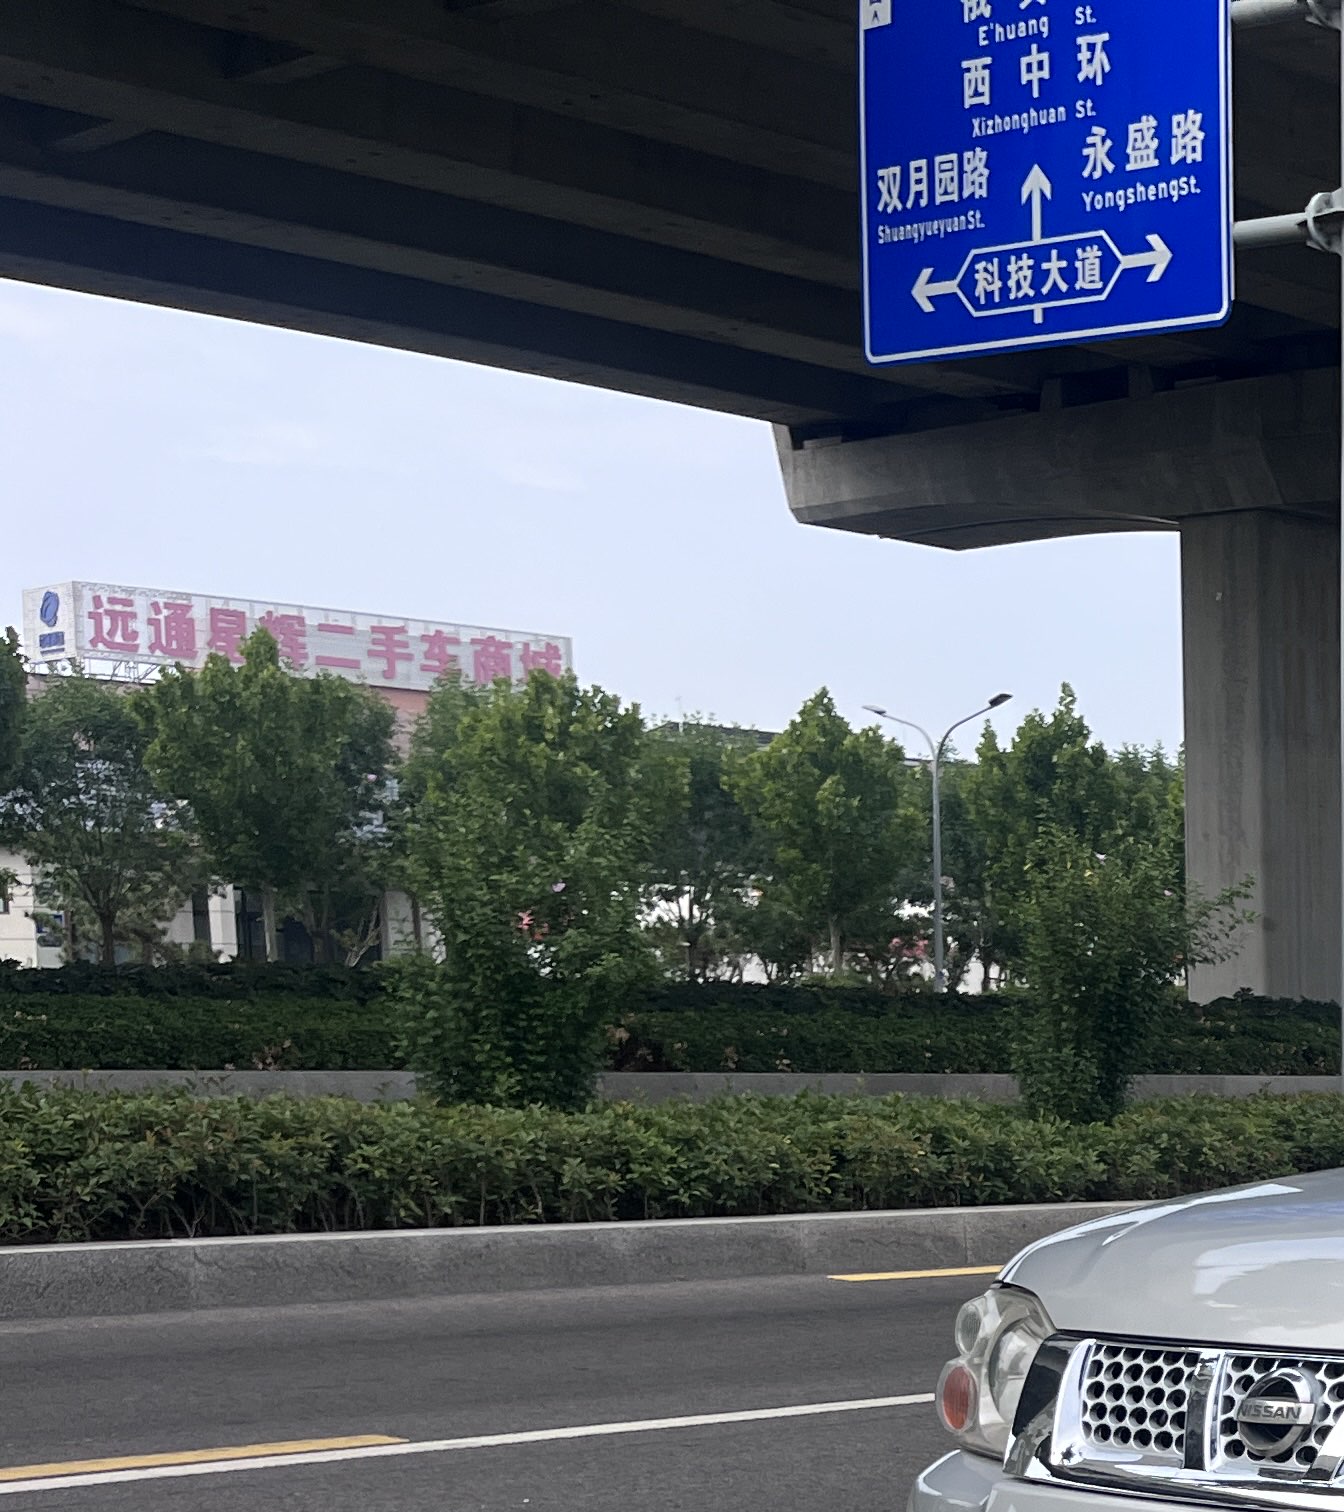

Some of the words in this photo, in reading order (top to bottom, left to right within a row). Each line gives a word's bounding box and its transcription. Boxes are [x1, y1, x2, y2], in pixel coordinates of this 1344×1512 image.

[979, 16, 1049, 46] E'huang
[1074, 5, 1097, 25] St.
[961, 32, 1111, 108] 西中环
[972, 106, 1067, 138] Xizhonghuan
[1075, 98, 1097, 118] St.
[1082, 108, 1205, 180] 永盛路
[877, 146, 990, 214] 双月园路
[974, 245, 1103, 304] 科技大道
[1237, 1402, 1303, 1420] NISSAN
